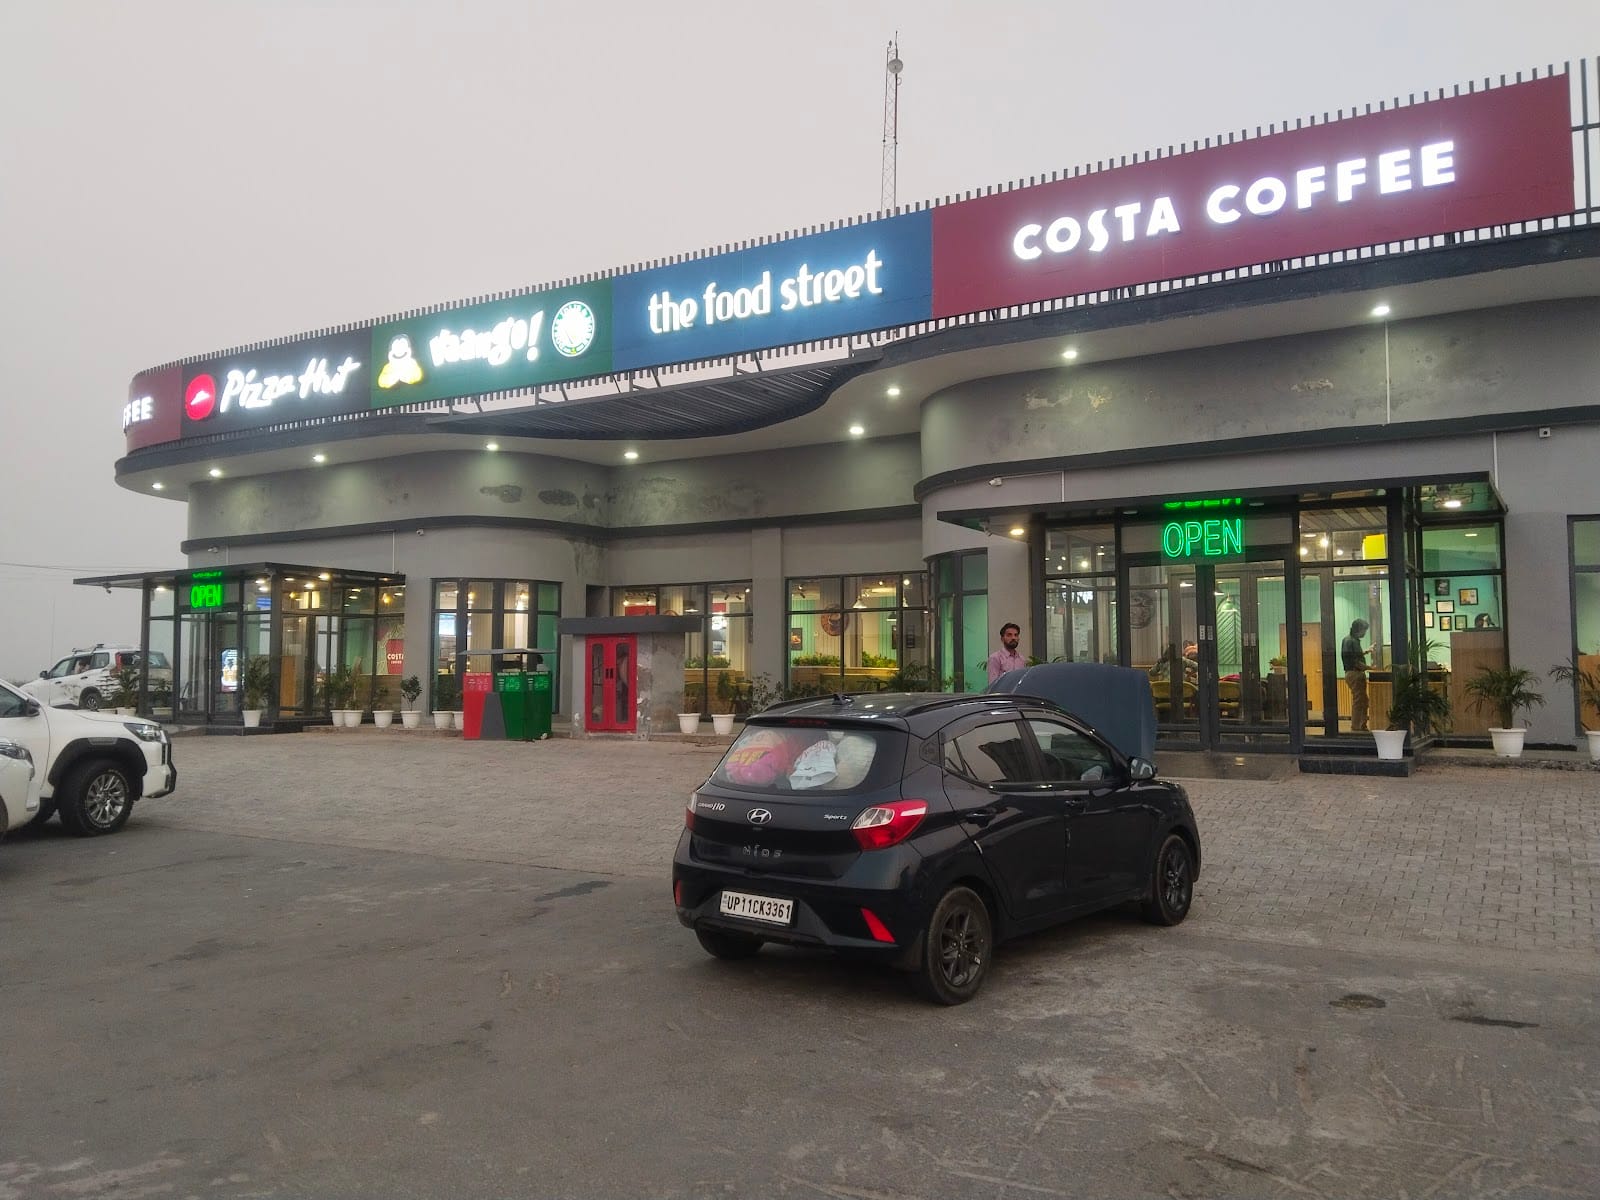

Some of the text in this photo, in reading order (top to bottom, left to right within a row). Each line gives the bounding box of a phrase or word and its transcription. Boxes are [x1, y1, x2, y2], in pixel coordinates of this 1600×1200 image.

[1013, 140, 1456, 261] COSTA COFFEE
[648, 291, 698, 334] the
[703, 271, 771, 325] food
[780, 249, 883, 311] street
[219, 356, 361, 413] Pizza Hut
[1163, 518, 1242, 558] OPEN
[190, 583, 223, 608] OPEN
[727, 895, 791, 920] UP11CK3361
